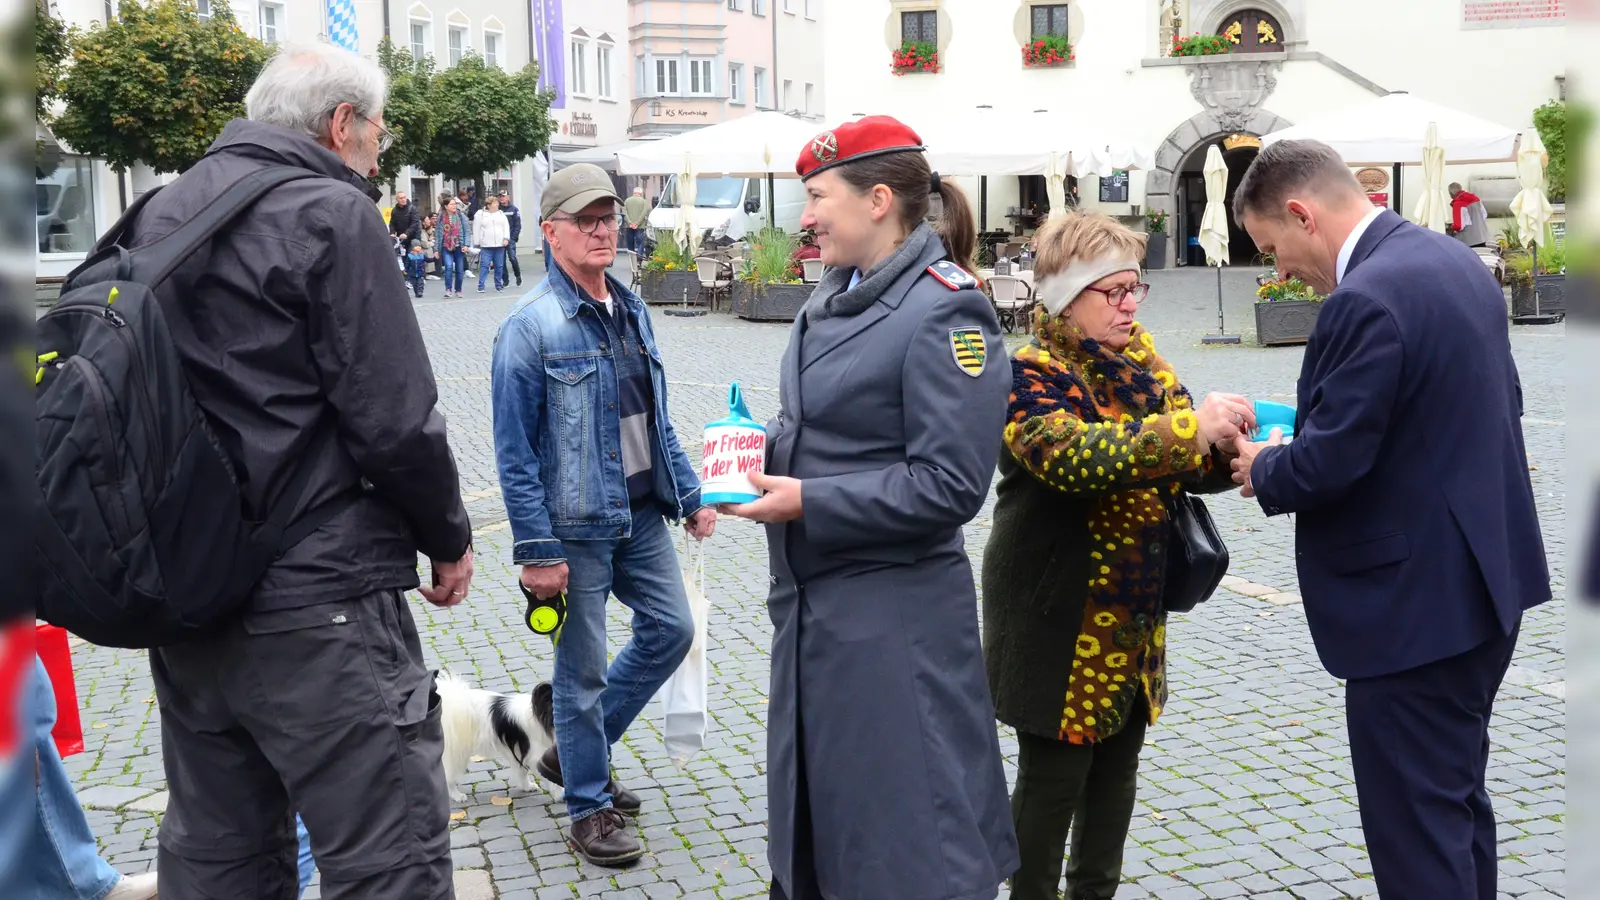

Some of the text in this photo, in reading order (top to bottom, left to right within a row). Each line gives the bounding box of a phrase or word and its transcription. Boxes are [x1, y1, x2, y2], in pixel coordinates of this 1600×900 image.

[665, 109, 676, 117] KS
[720, 431, 764, 453] Frieden
[711, 458, 733, 478] der
[737, 454, 762, 473] Welt
